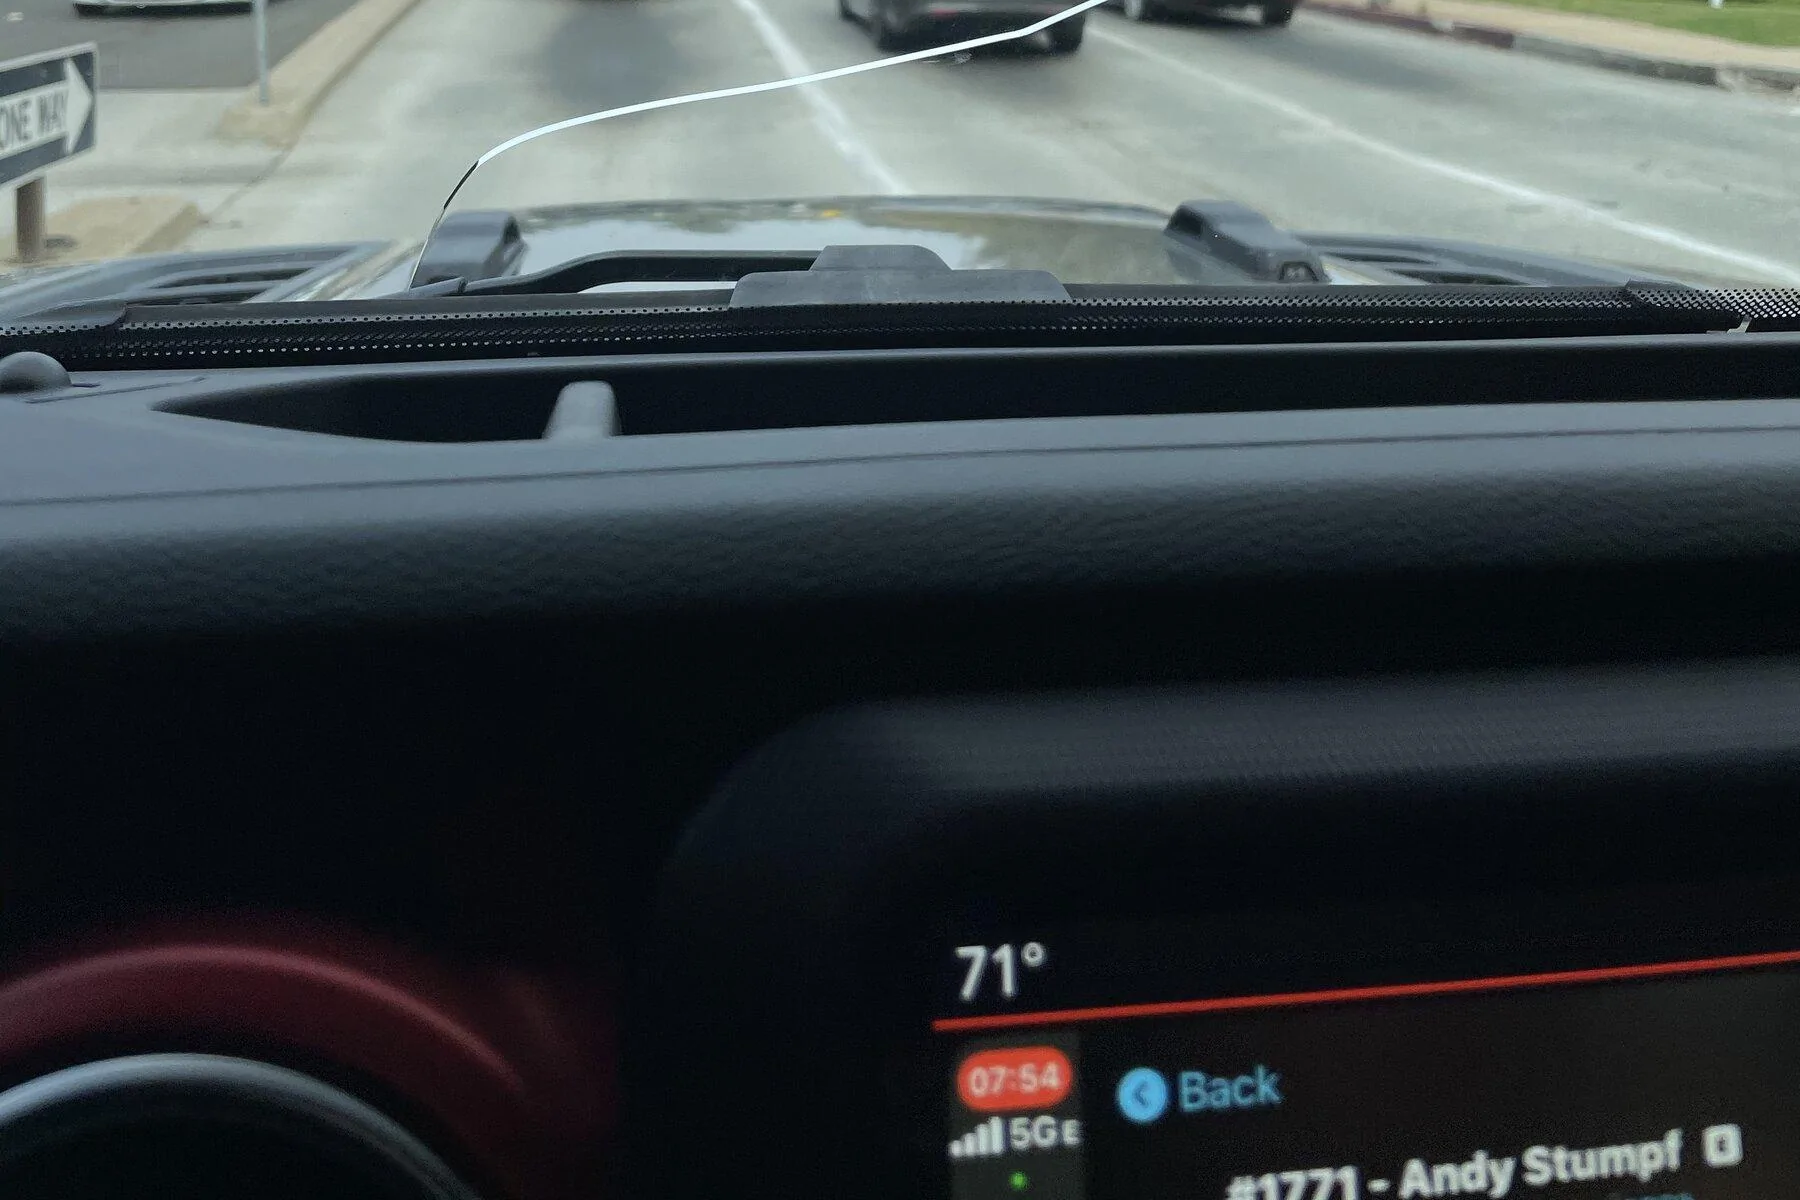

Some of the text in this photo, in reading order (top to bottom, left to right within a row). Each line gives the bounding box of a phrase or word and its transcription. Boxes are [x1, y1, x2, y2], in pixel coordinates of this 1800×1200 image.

[38, 87, 68, 138] WAY
[955, 942, 1046, 1001] 71°
[968, 1061, 1062, 1097] 07:54
[1178, 1063, 1284, 1112] Back
[1225, 1165, 1359, 1200] #1771
[1397, 1149, 1516, 1199] Andy
[1521, 1128, 1683, 1187] Stumpf
